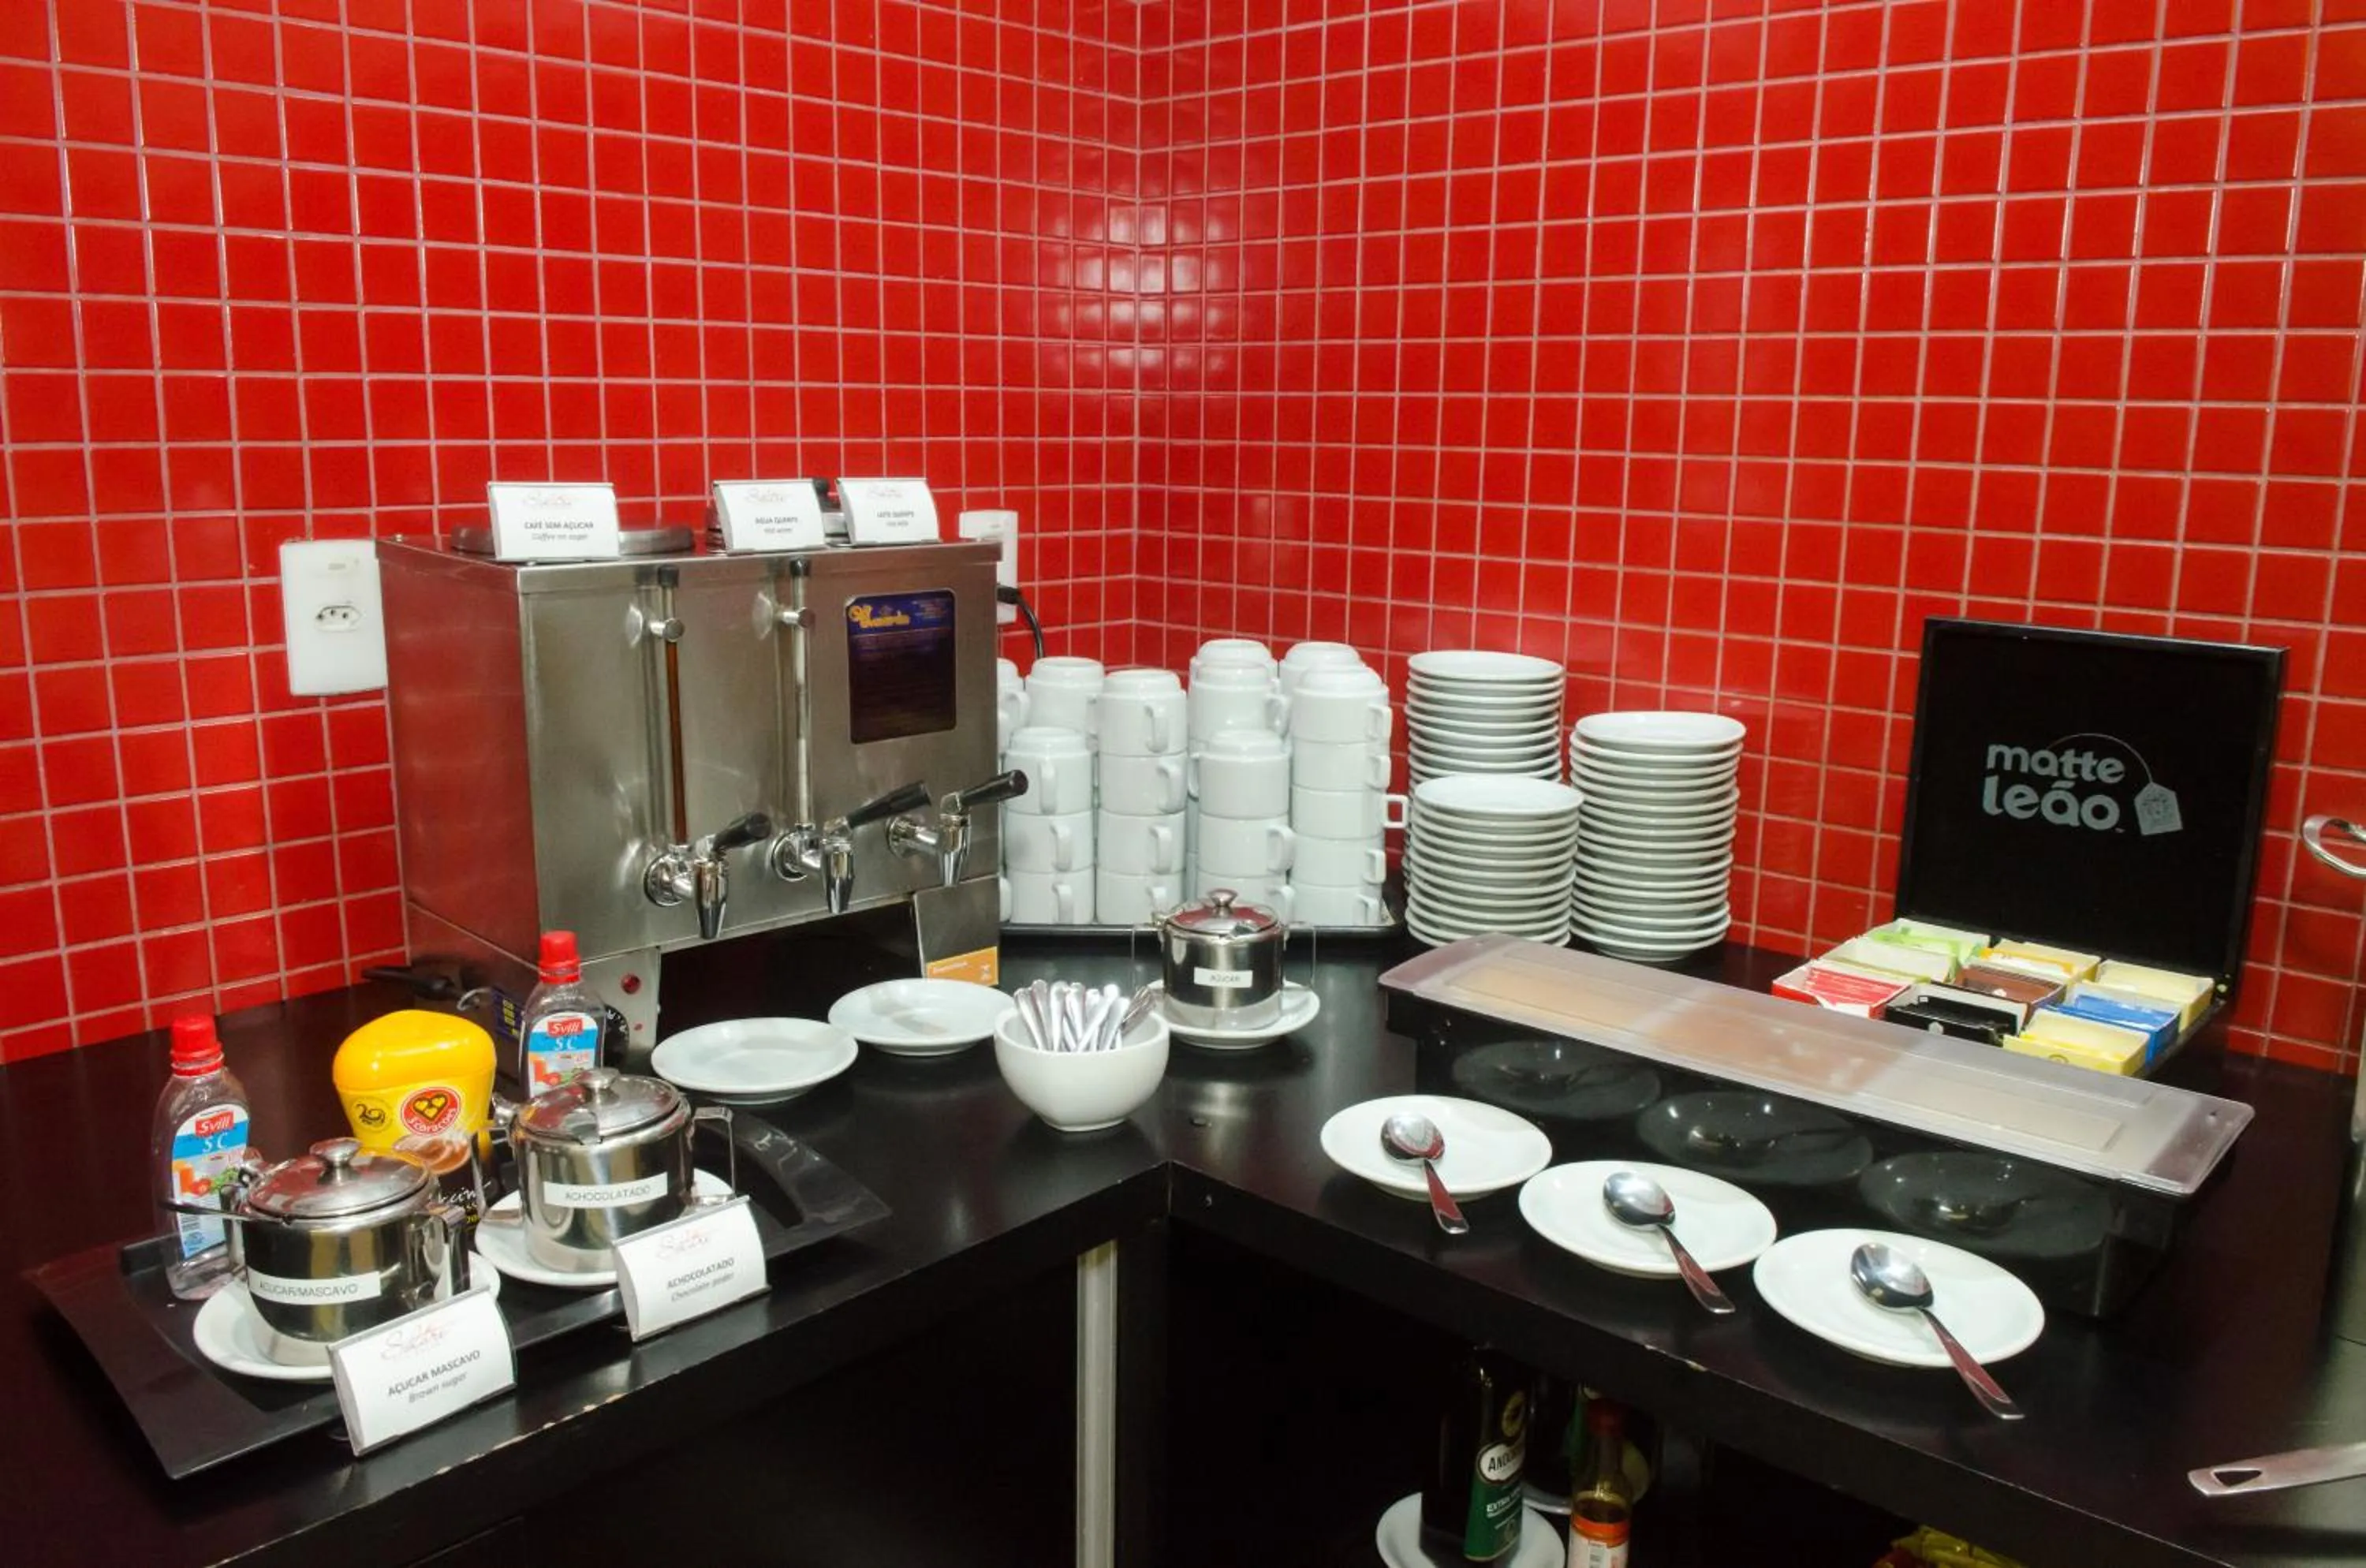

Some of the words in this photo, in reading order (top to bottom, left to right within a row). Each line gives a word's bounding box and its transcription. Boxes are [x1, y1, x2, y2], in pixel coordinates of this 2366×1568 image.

[1986, 744, 2126, 784] matte
[1982, 775, 2121, 831] leão
[565, 1185, 651, 1202] ACHOCOLATADO
[666, 1257, 735, 1289] ACHOCOLATADO
[431, 1350, 481, 1377] MASCAVO
[408, 1384, 440, 1403] Brown
